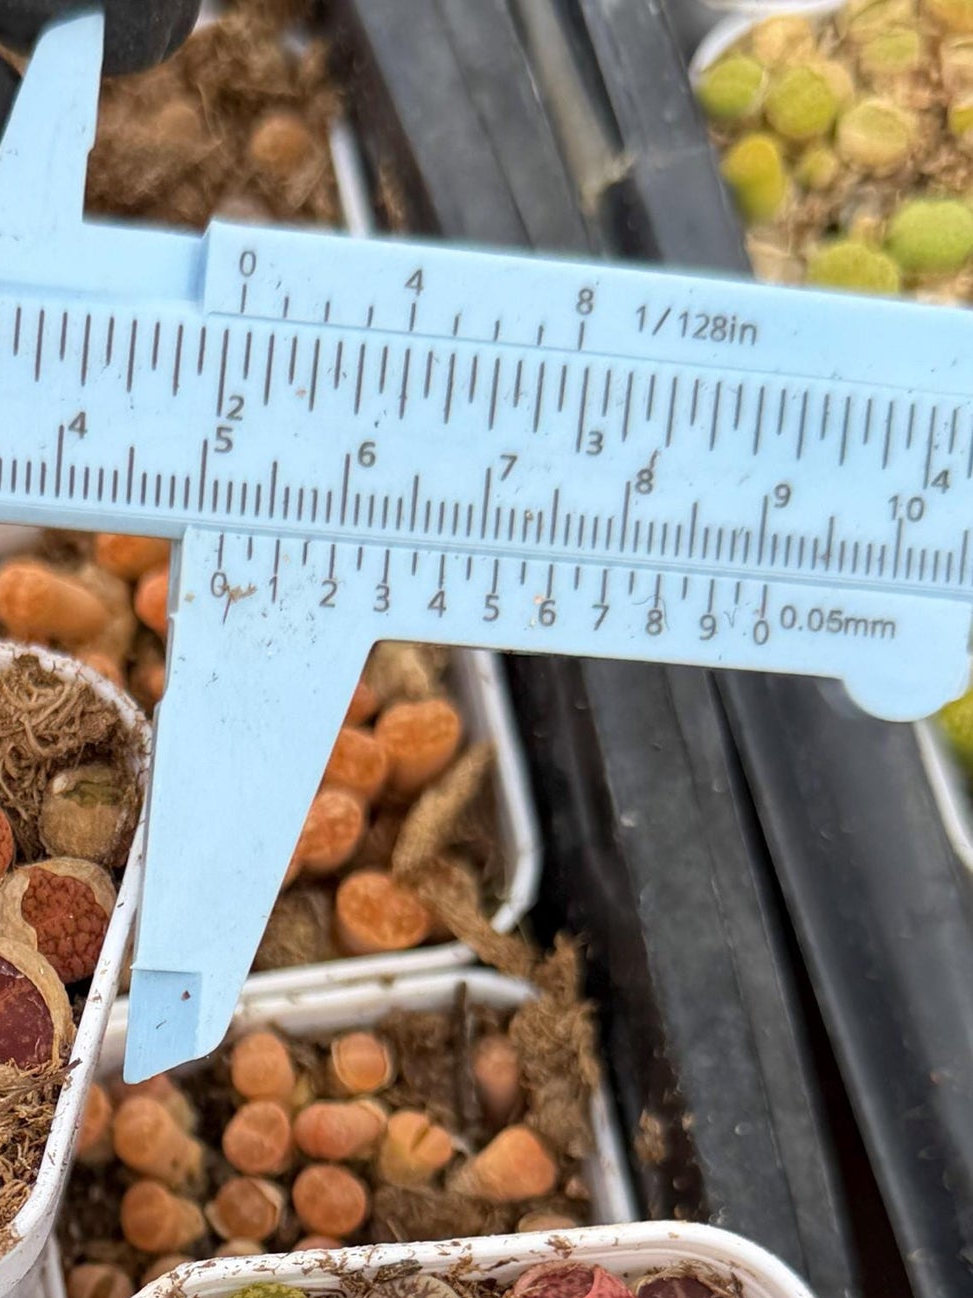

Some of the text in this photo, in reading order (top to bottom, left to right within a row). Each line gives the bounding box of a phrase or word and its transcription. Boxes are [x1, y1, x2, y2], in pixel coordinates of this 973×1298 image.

[238, 250, 758, 346] 0 4 8 1/128in
[67, 411, 88, 440] 4
[214, 426, 233, 454] 5
[357, 441, 376, 468] 6
[500, 454, 518, 481] 7
[634, 468, 653, 495] 8
[773, 483, 792, 509] 9
[887, 494, 925, 523] 10
[225, 394, 245, 421] 2
[585, 430, 604, 456] 3
[930, 469, 950, 494] 4
[210, 571, 897, 646] 0 1 2 3 4 5 6 7 8 9 0 0.05mm
